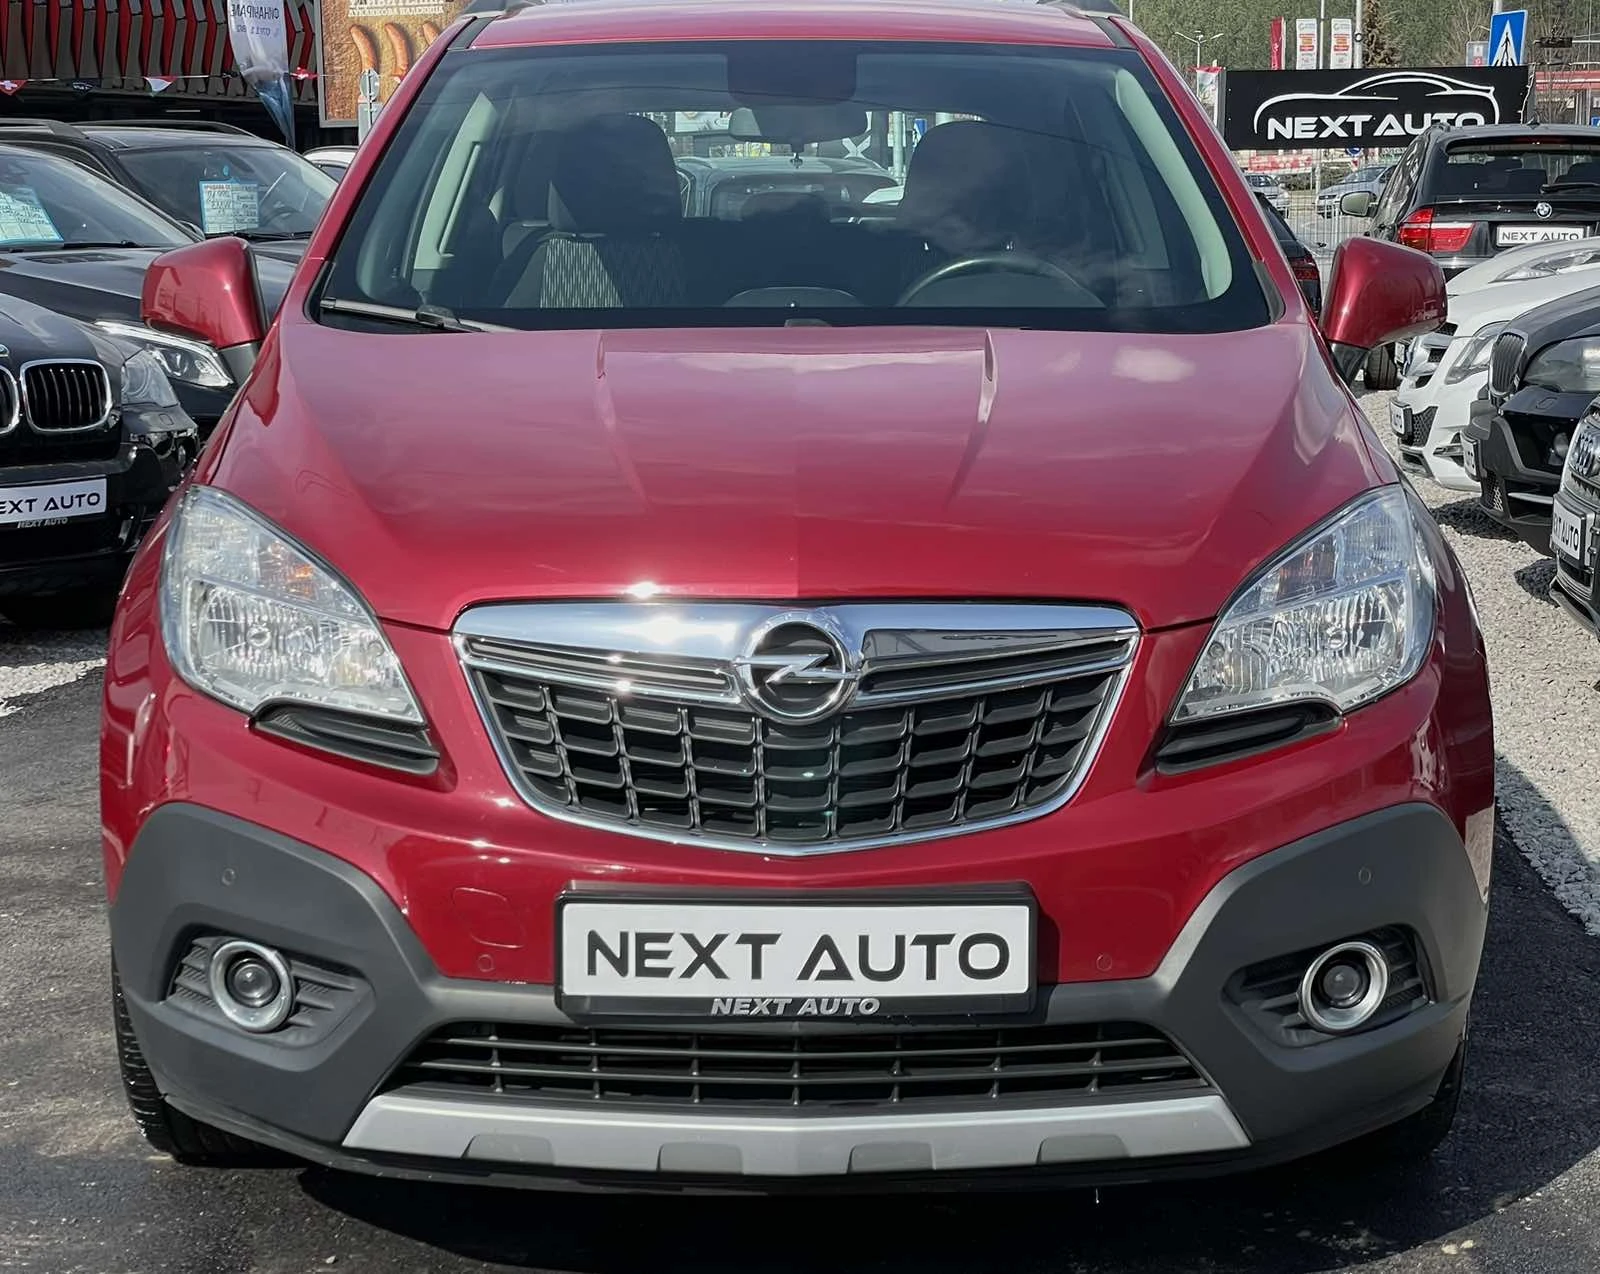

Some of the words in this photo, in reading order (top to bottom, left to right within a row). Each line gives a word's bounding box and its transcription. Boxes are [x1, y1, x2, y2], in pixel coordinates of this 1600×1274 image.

[1267, 114, 1373, 140] NEXT
[1502, 231, 1538, 241] NEXT
[1540, 232, 1579, 241] AUTO
[0, 498, 38, 514] EXT
[44, 492, 100, 511] AUTO
[44, 517, 68, 527] AUTO
[587, 929, 782, 980] NEXT
[797, 932, 1010, 982] AUTO
[711, 997, 792, 1016] NEXT
[797, 997, 880, 1016] AUTO
